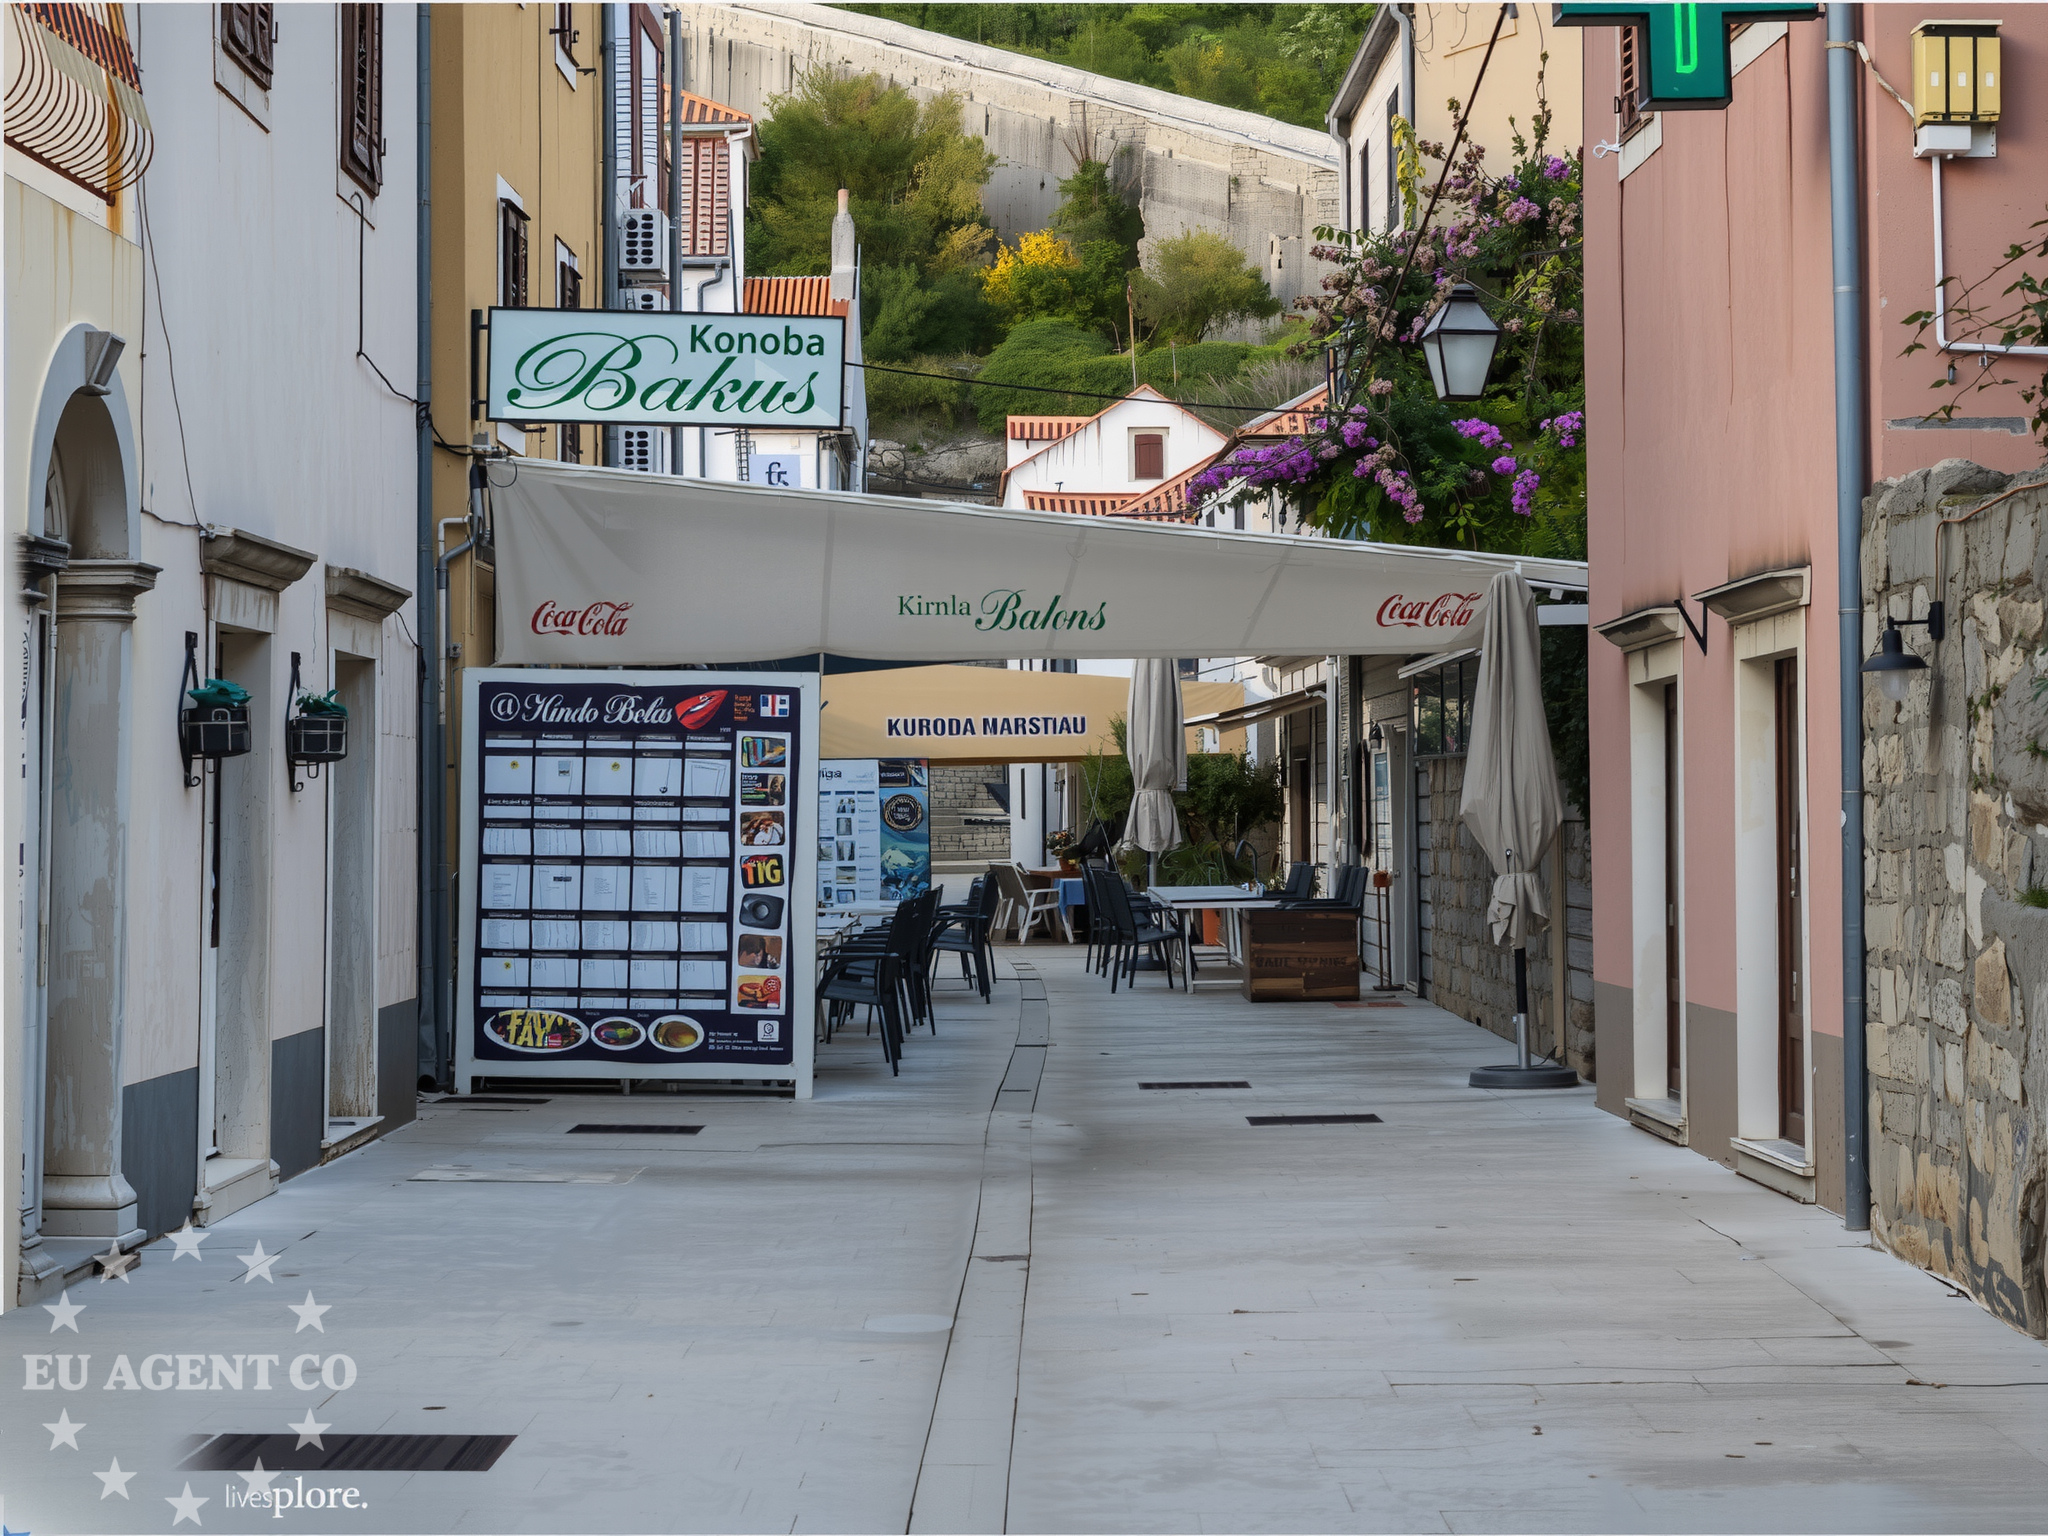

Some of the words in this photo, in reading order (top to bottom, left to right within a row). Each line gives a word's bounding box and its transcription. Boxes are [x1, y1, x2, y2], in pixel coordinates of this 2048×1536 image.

[690, 324, 826, 356] Konoba
[506, 331, 819, 415] Bakus
[897, 594, 972, 616] Kirnla
[887, 717, 976, 737] KURODA
[982, 715, 1087, 736] MARSTIAU
